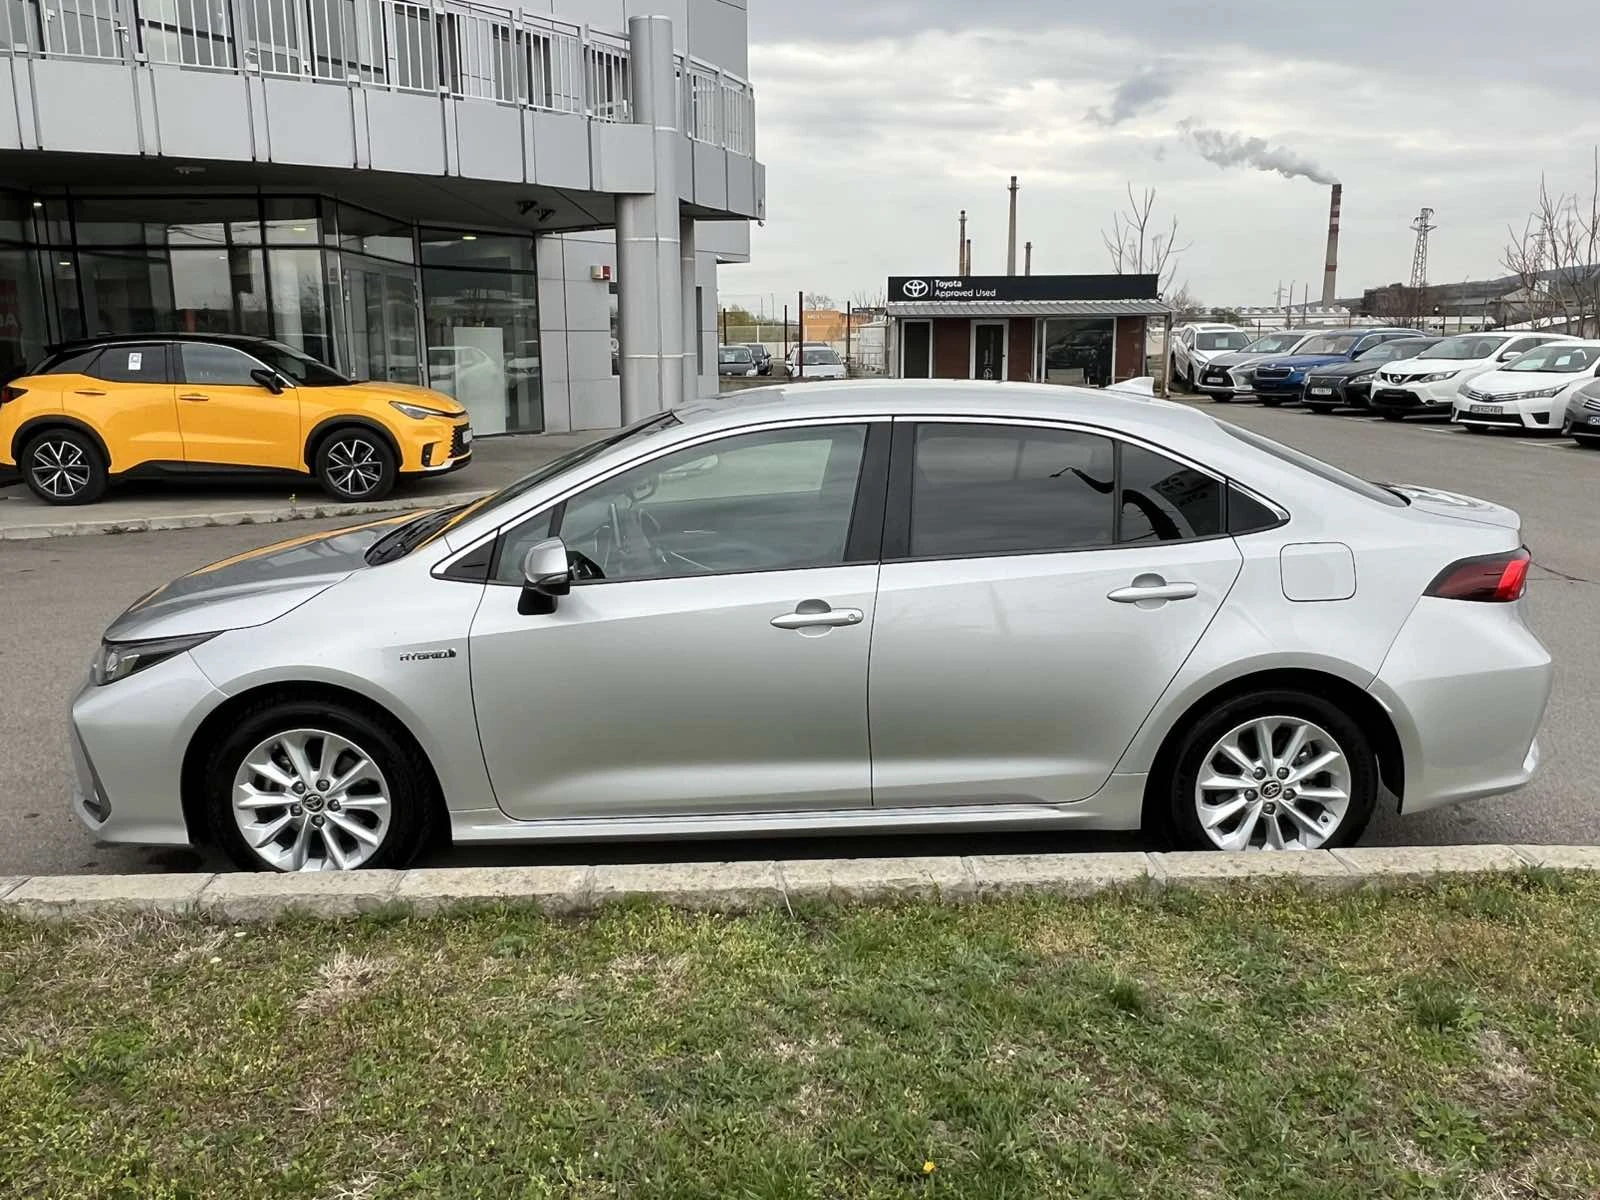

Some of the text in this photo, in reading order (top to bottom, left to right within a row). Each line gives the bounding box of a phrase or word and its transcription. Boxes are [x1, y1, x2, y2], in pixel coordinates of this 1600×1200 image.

[935, 280, 962, 289] Toyota
[935, 289, 973, 298] Approved
[400, 651, 448, 661] HYBRID
